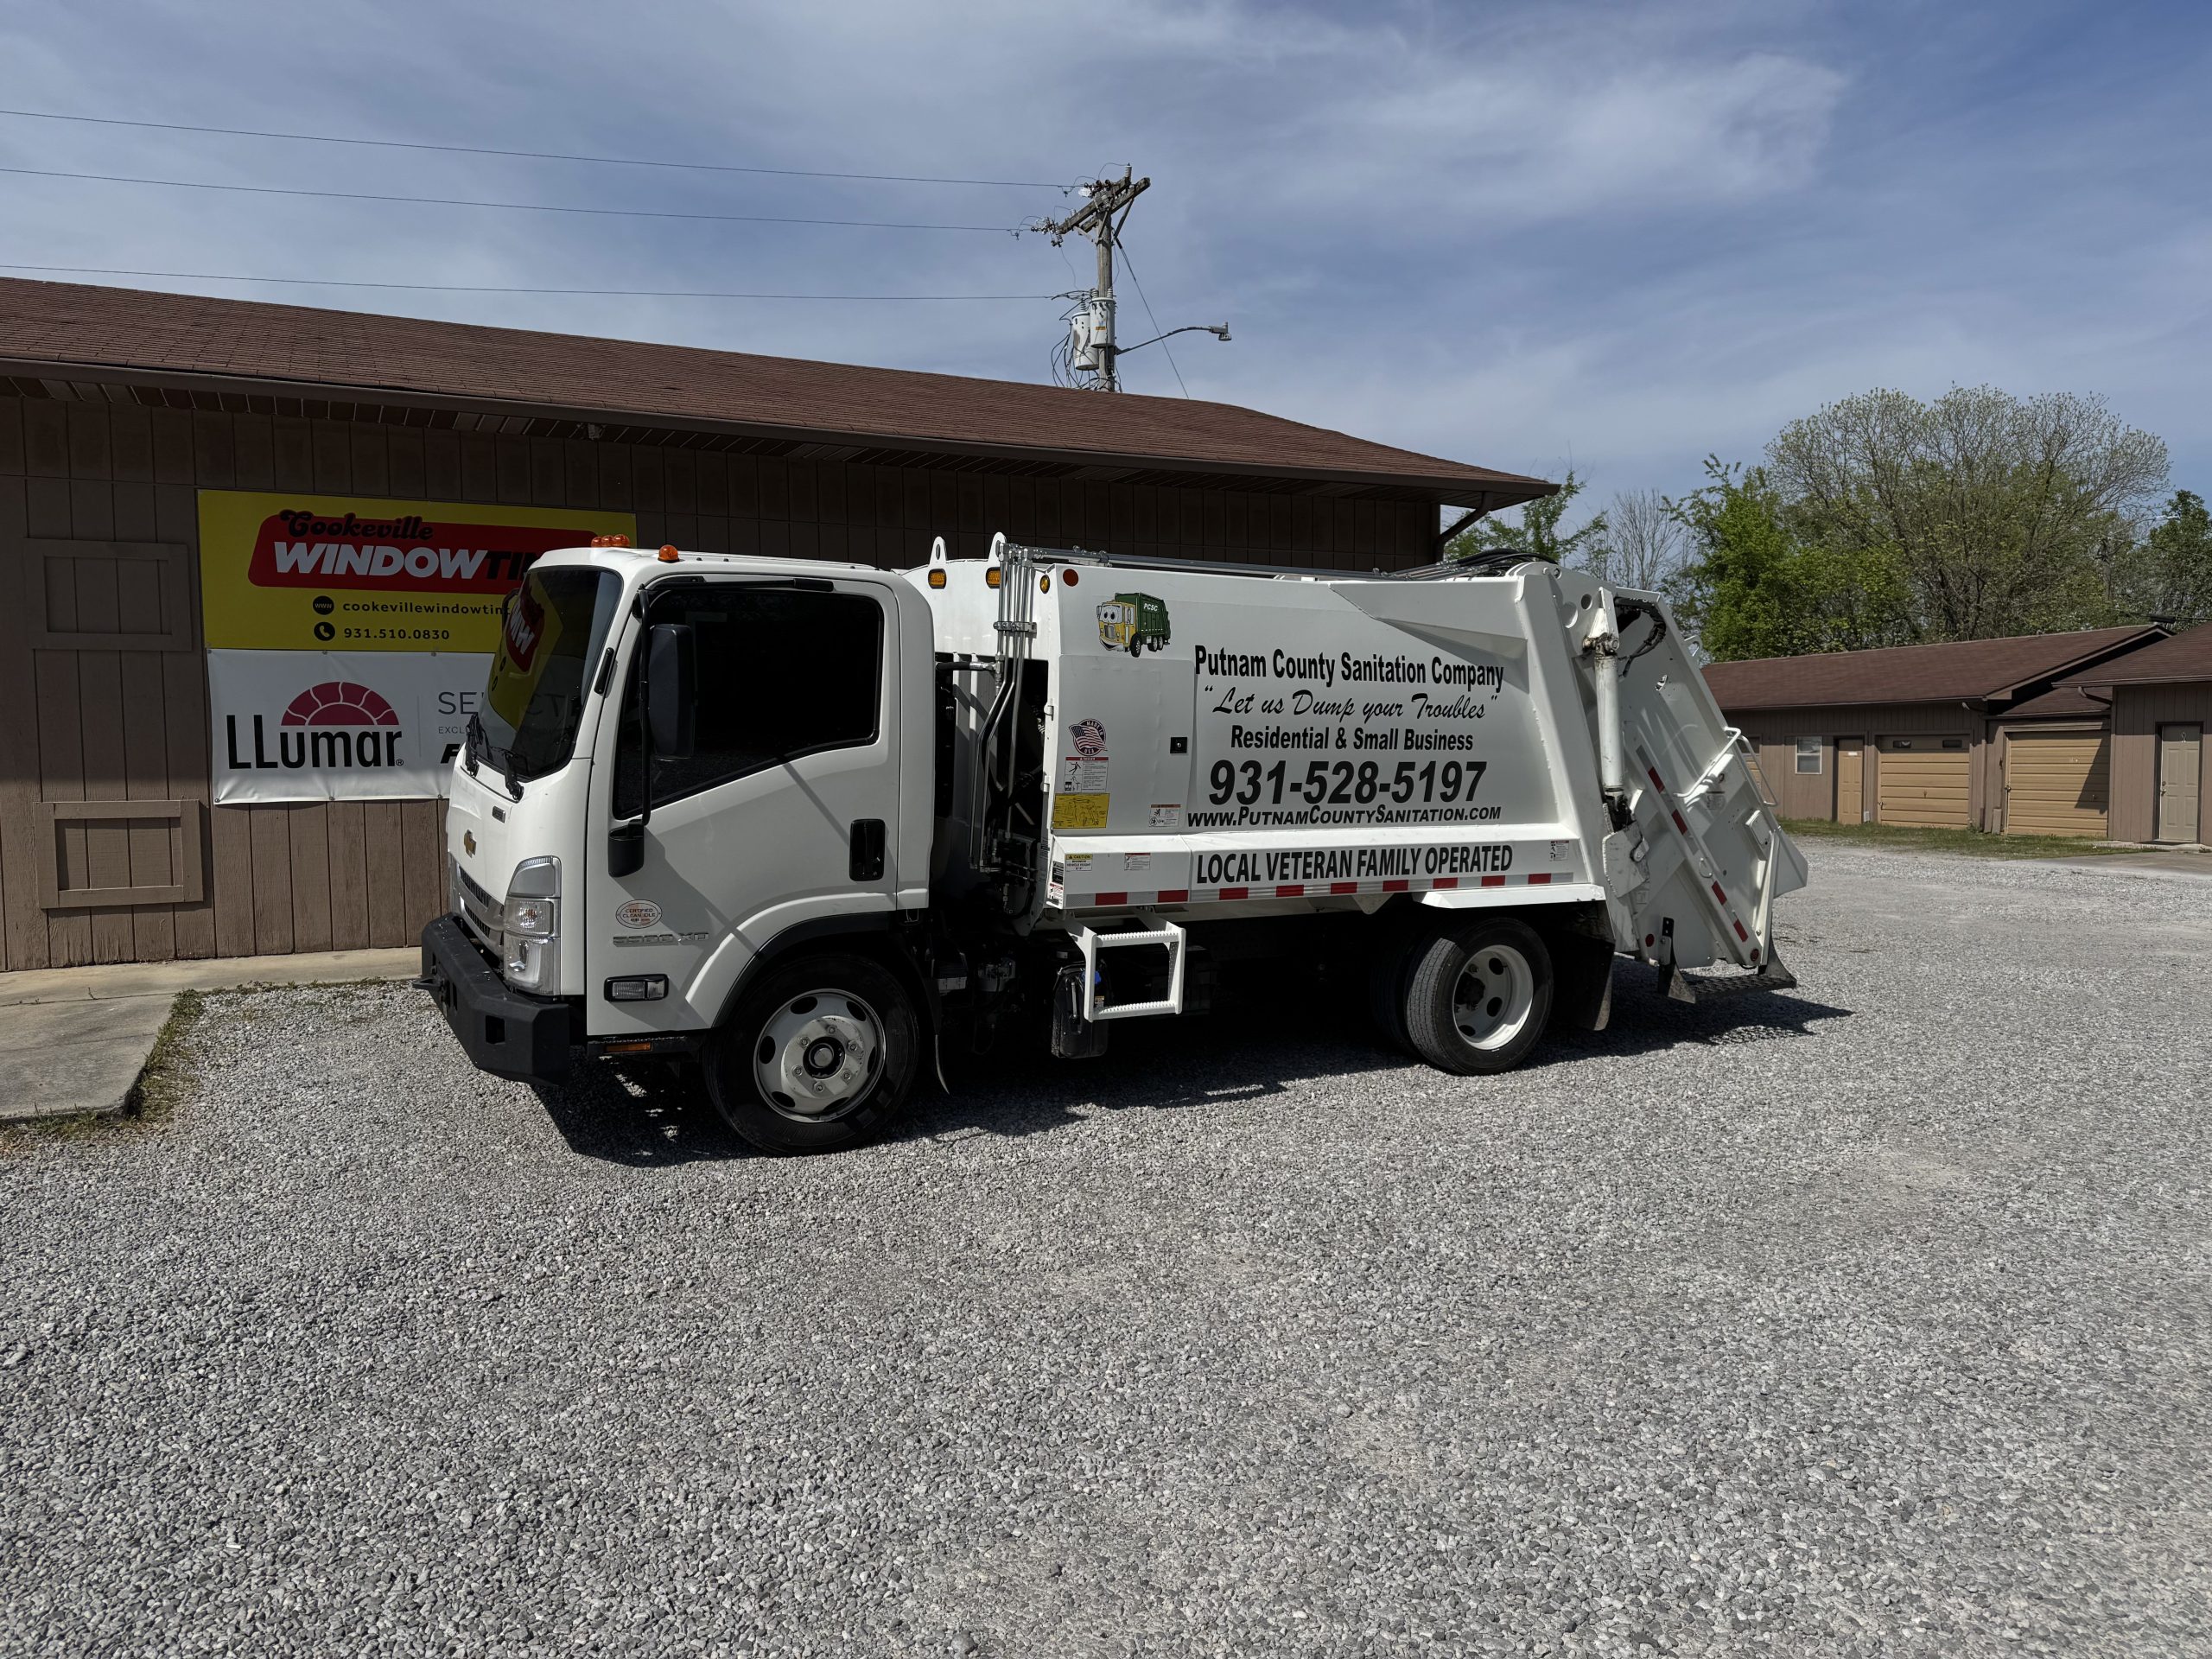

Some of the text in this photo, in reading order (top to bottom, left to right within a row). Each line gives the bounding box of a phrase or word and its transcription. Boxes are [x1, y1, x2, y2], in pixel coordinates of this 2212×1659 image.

[280, 510, 433, 540] Cookeville
[1144, 603, 1158, 612] PCSC
[344, 628, 450, 640] 931.510.0830
[1194, 645, 1504, 694] Putnam County Sanitation Company
[1261, 697, 1285, 715] us
[1292, 689, 1356, 723] Dump
[1362, 701, 1404, 724] your
[1230, 724, 1473, 751] Residential & Small Business
[1208, 759, 1488, 805] 931-528-5197
[1197, 844, 1513, 884] LOCAL VETERAN FAMILY OPERATED
